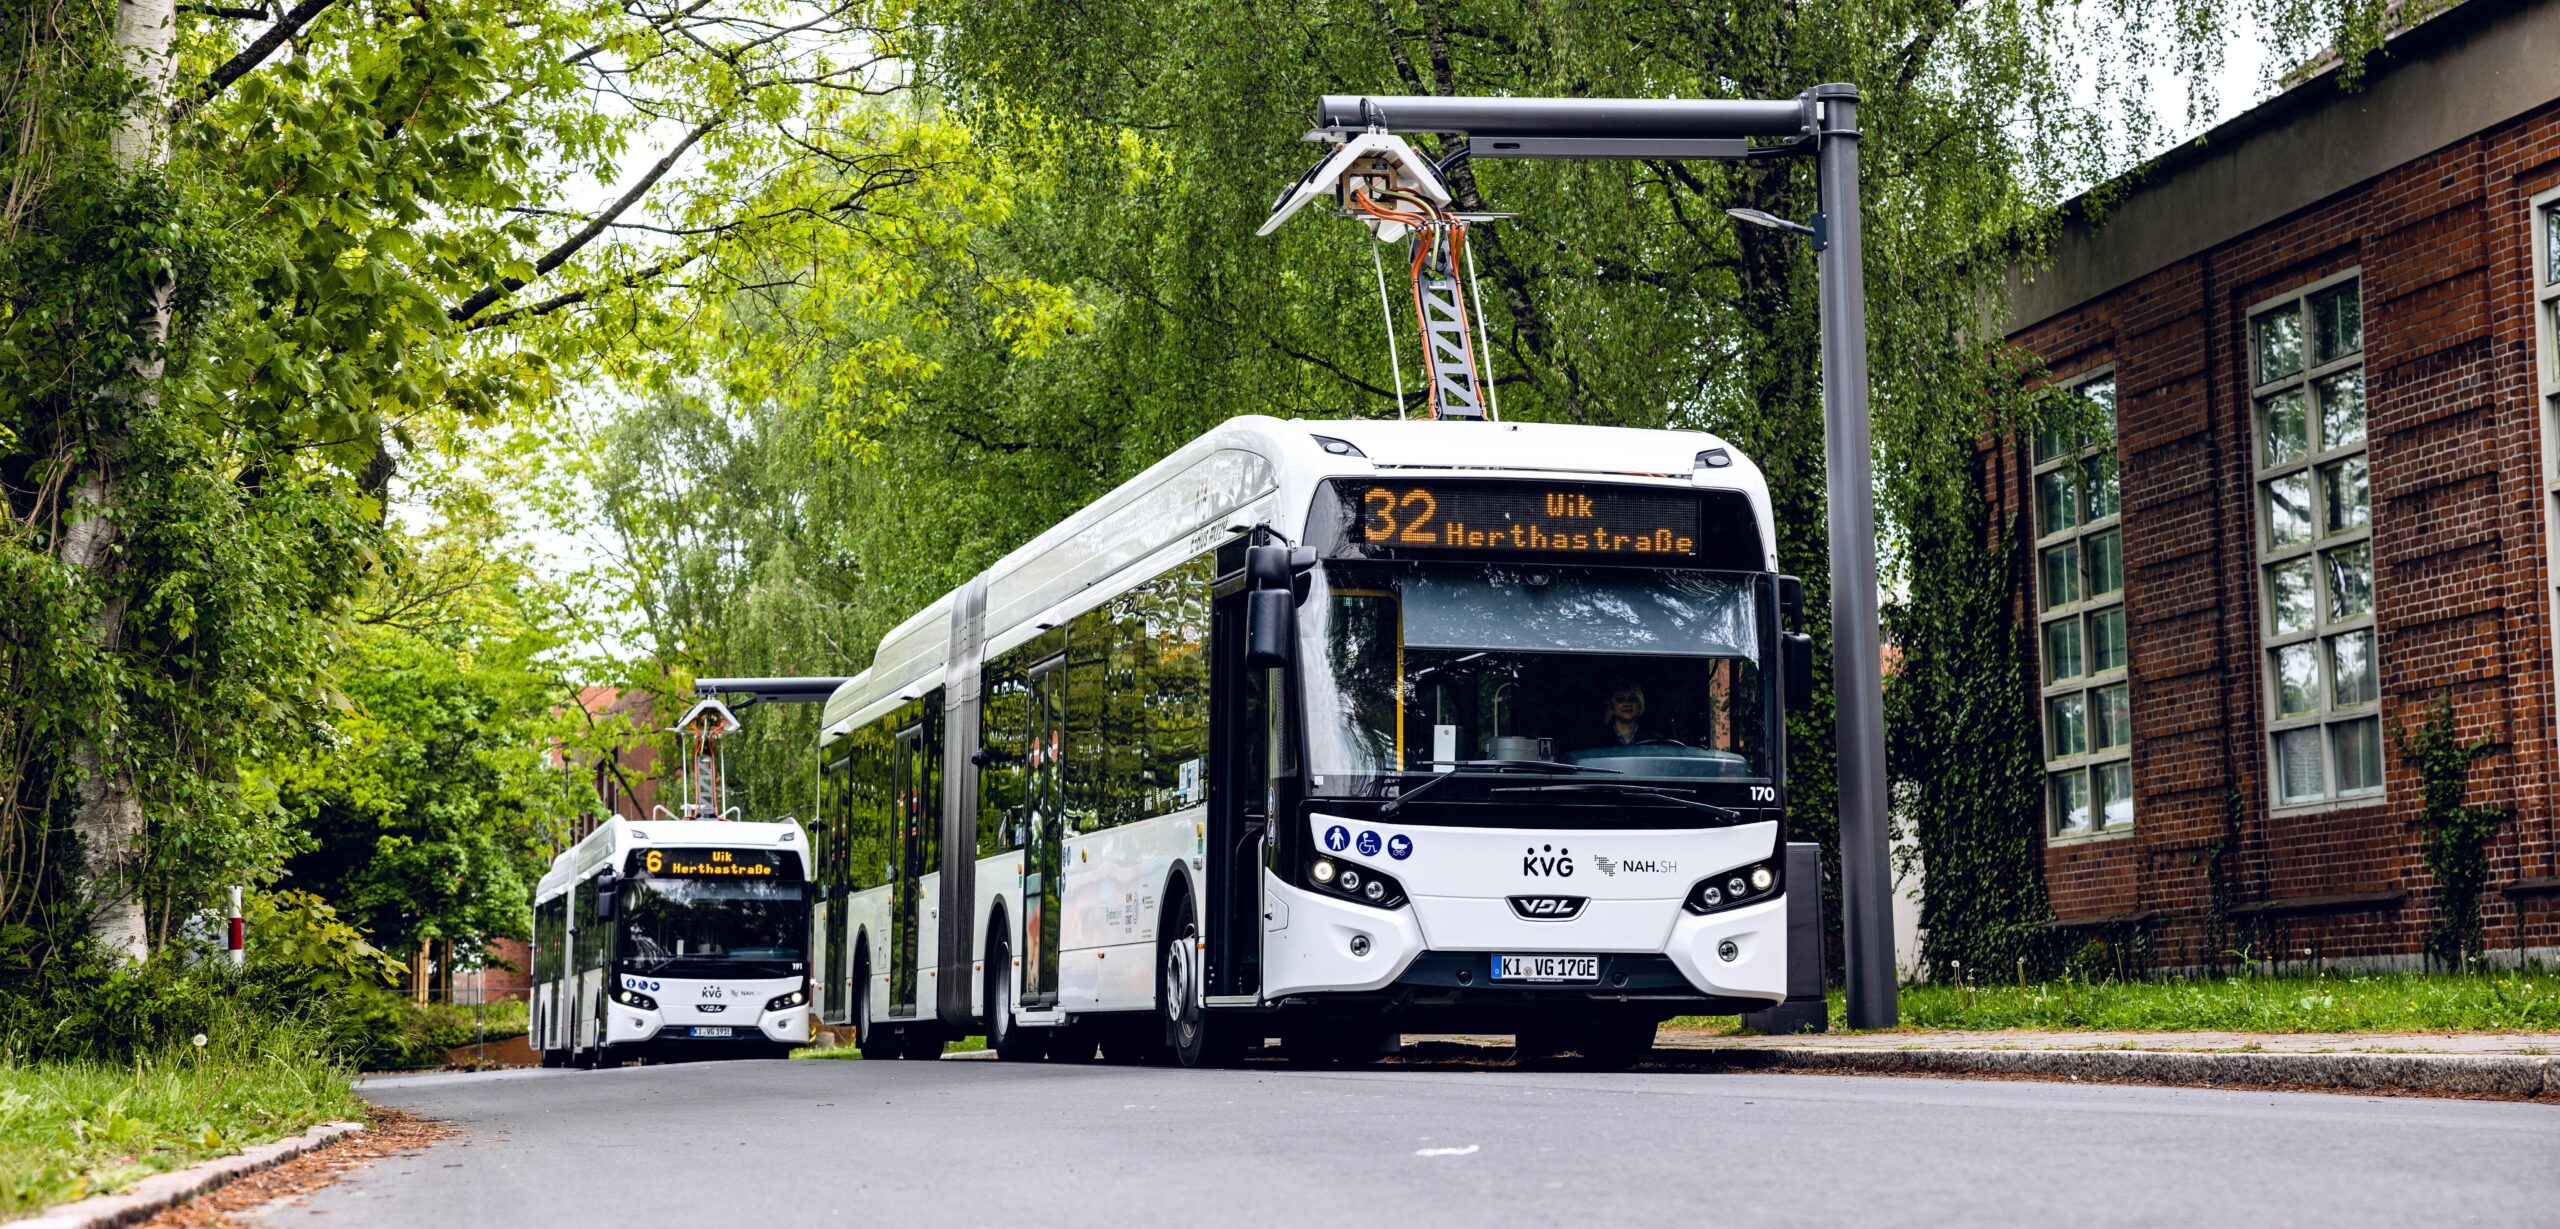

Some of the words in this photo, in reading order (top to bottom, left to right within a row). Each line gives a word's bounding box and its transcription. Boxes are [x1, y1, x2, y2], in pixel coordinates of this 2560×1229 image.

[1547, 493, 1593, 518] Wik
[1364, 488, 1436, 543] 32
[1447, 522, 1693, 553] Herthastraße
[1750, 786, 1775, 802] 170
[646, 850, 663, 873] 6
[712, 851, 732, 862] Wik
[672, 863, 772, 875] Herthastraße
[1523, 856, 1574, 878] KVG
[1623, 860, 1678, 873] NAH.SH
[1518, 899, 1574, 914] VDL
[791, 962, 803, 971] 191
[1502, 958, 1522, 976] KI
[1534, 958, 1554, 977] VG
[1558, 959, 1596, 977] 170E
[701, 990, 722, 998] KVG
